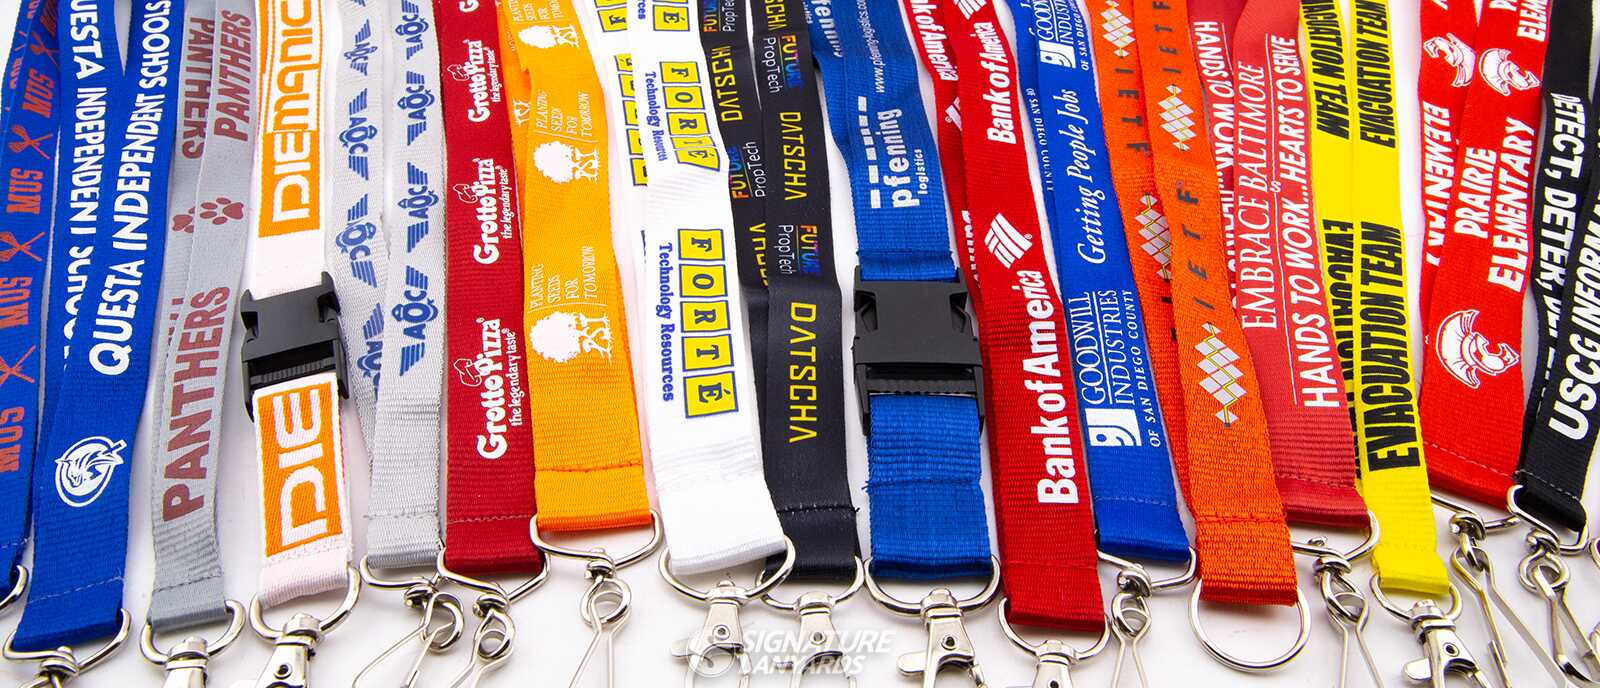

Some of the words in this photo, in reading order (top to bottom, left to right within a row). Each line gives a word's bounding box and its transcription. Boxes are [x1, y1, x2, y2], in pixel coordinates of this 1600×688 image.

[69, 0, 106, 80] UESTA
[138, 0, 172, 89] SCHOOLS
[721, 0, 738, 32] PropTe
[970, 21, 1009, 65] America
[1193, 21, 1229, 79] HANDS
[1300, 0, 1346, 81] VACUATION
[182, 16, 216, 160] PANTHERS
[213, 10, 252, 142] PANTHERS
[761, 36, 784, 94] PropTech
[979, 61, 1011, 89] of
[1270, 35, 1303, 77] SERVE
[1274, 78, 1305, 102] TO
[1355, 37, 1397, 149] EVACUATION
[644, 71, 661, 128] Technology
[982, 90, 1017, 145] Bank
[1053, 88, 1089, 125] Jobs
[1237, 60, 1270, 194] BALTIMORE
[1312, 80, 1351, 141] TEAM
[6, 167, 44, 216] MUS
[111, 93, 166, 250] INDEPENDENT
[778, 111, 809, 201] DATSCHA
[876, 108, 921, 209] pfenning
[914, 148, 929, 195] logistics
[1058, 126, 1097, 184] People
[1452, 146, 1498, 240] PRAIRIE
[1075, 186, 1106, 265] Getting
[1487, 116, 1536, 294] ELEMENTARY
[655, 242, 673, 320] Technology
[773, 224, 797, 275] PropTech
[1236, 195, 1279, 330] EMBRACE
[1360, 220, 1405, 288] TEAM
[1571, 191, 1600, 334] INFORM
[88, 258, 145, 376] QUESTA
[1011, 269, 1061, 378] America
[1121, 289, 1139, 340] COUNTY
[1287, 274, 1322, 306] TO
[474, 317, 503, 377] Pizza
[504, 353, 526, 411] legendary
[660, 323, 676, 402] Resources
[788, 301, 818, 444] DATSCHA
[1067, 291, 1107, 406] GOODWILL
[1097, 289, 1136, 406] INDUSTRIES
[1130, 346, 1149, 391] DIEGO
[1291, 312, 1340, 409] HANDS
[1359, 291, 1422, 472] EVACUATION
[162, 285, 231, 522] PANTHERS
[476, 374, 509, 460] Grotto
[508, 410, 524, 427] the
[1023, 378, 1067, 413] of
[1143, 397, 1157, 424] SAN
[1548, 333, 1598, 441] USCG
[271, 387, 329, 549] DIE
[1030, 415, 1080, 505] Bank
[1150, 430, 1161, 448] OF
